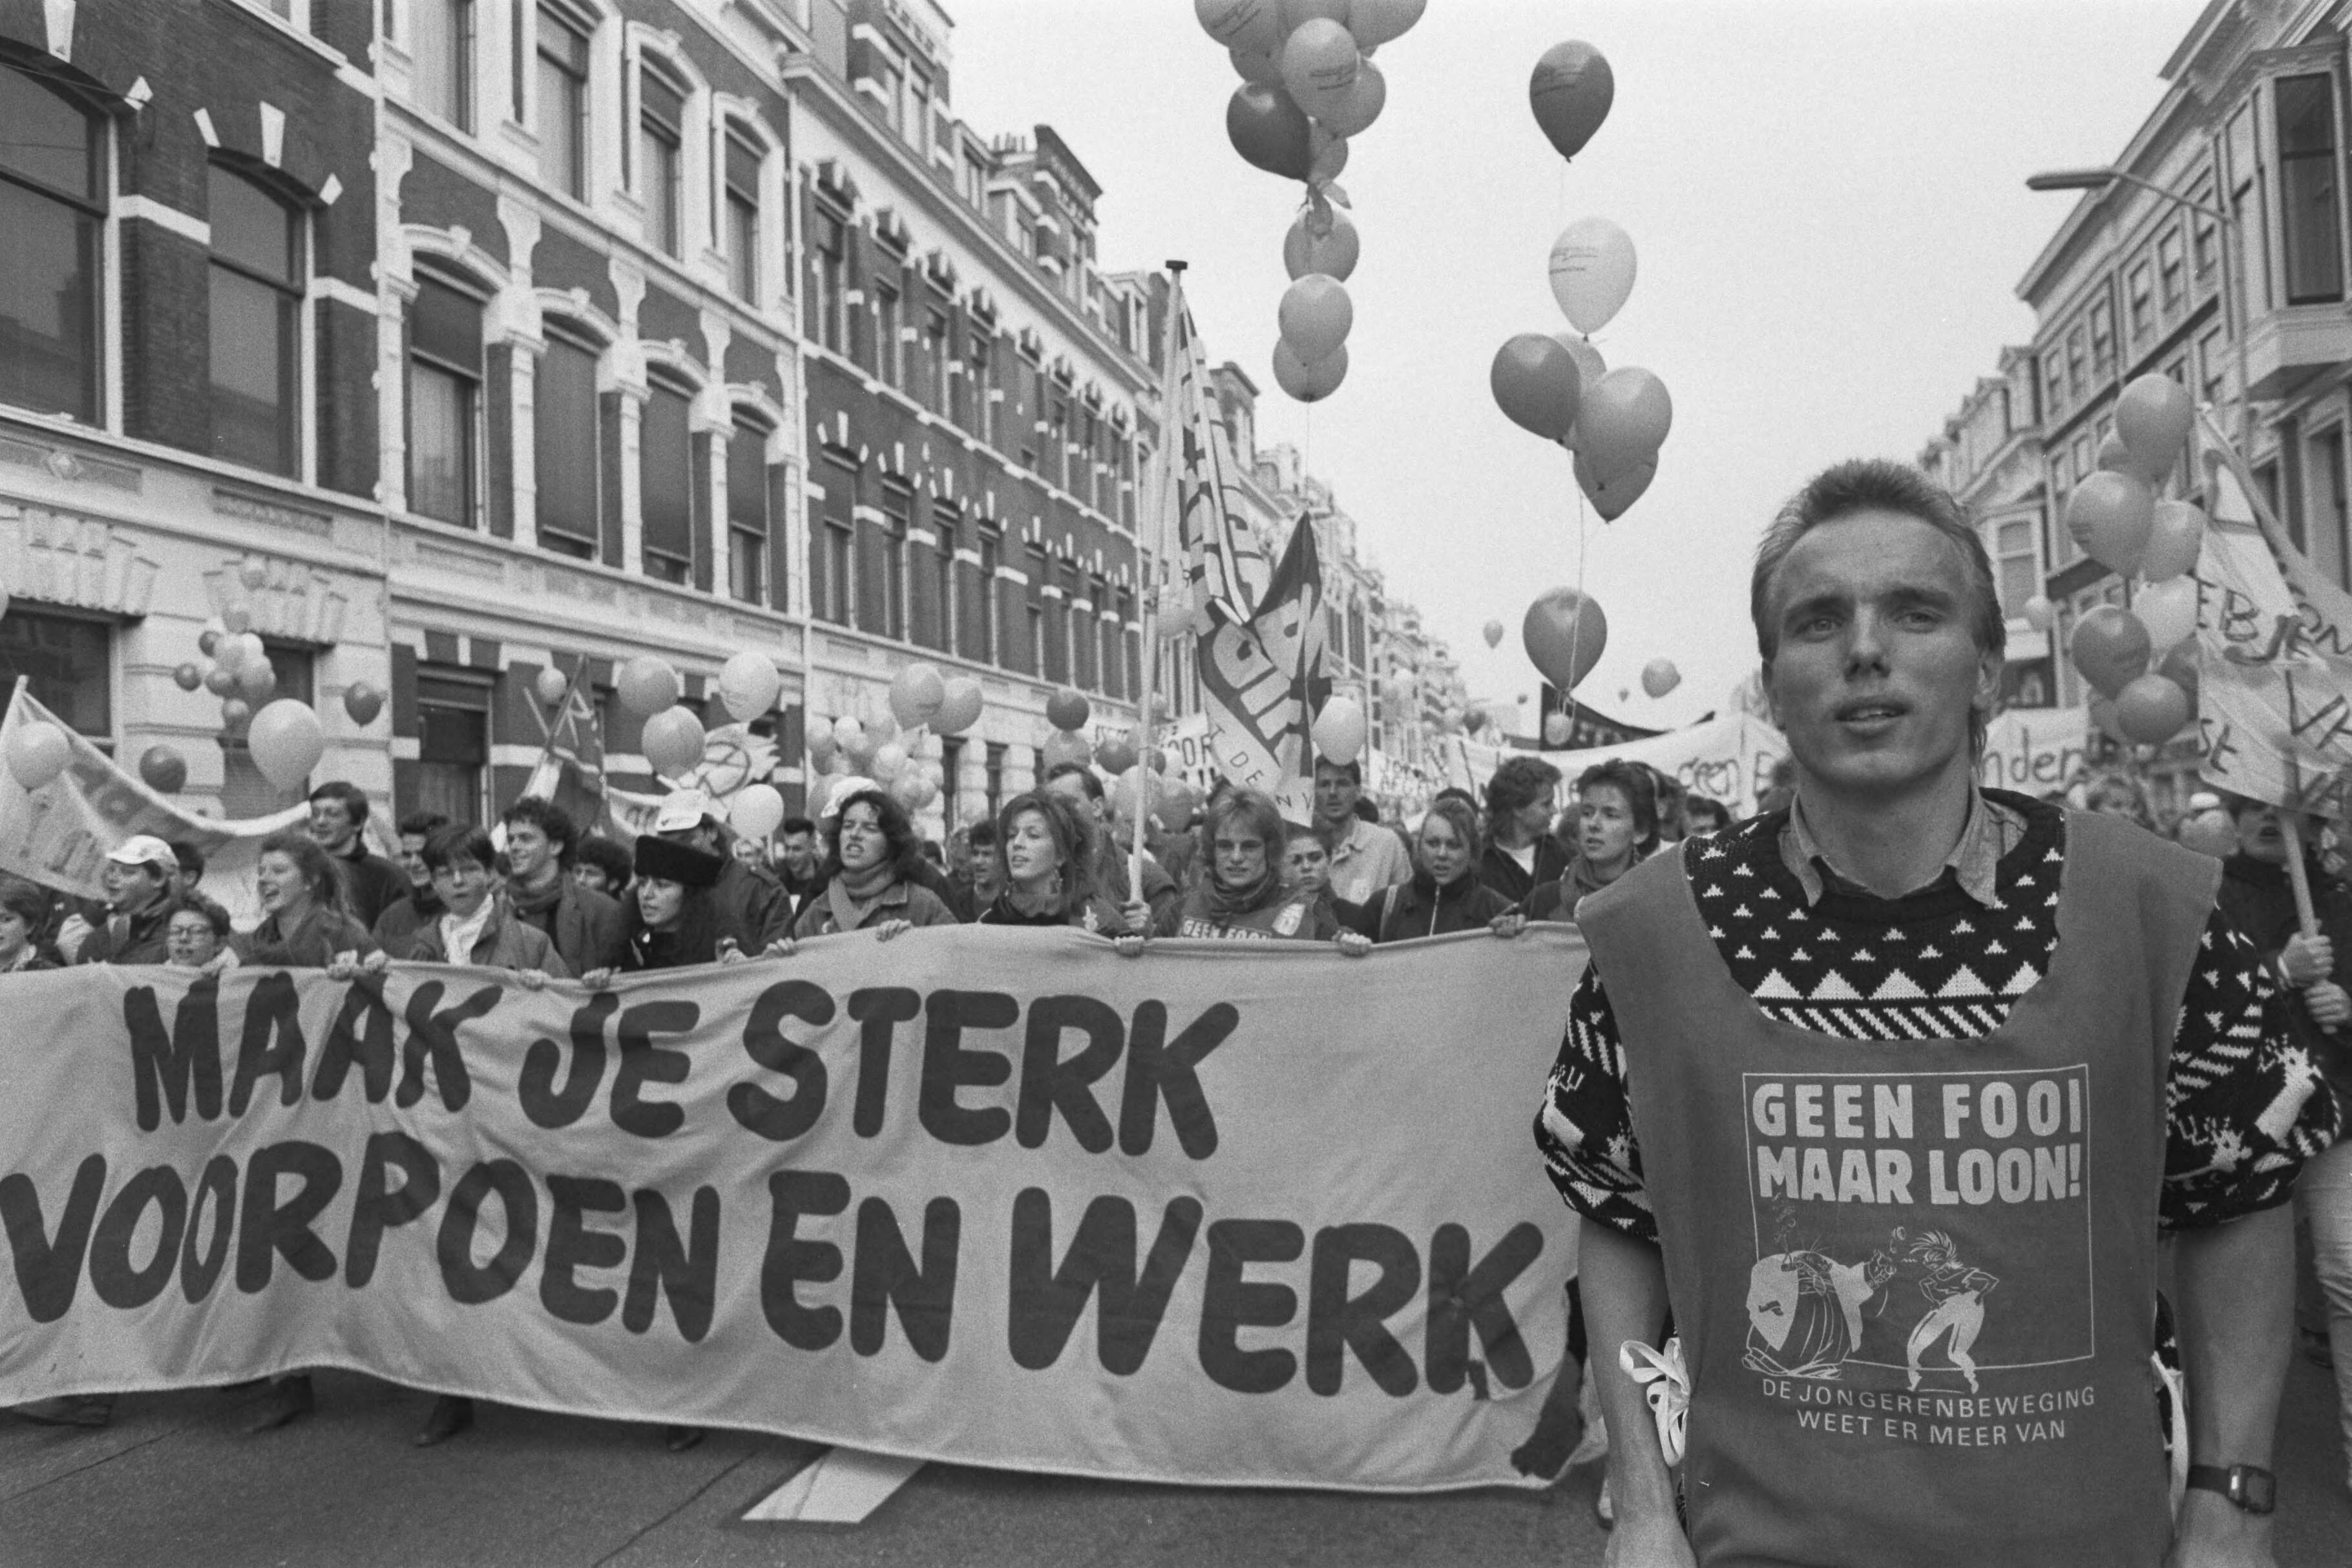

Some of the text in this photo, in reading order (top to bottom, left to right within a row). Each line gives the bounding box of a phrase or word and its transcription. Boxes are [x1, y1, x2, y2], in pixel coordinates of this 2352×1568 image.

[124, 970, 1239, 1160] MAAK JE STERK
[1752, 1078, 2081, 1140] GEEN FOOI
[1756, 1143, 2081, 1206] MAAR LOON!
[761, 1170, 961, 1363] EN
[1008, 1187, 1544, 1398] WERK
[1763, 1379, 2095, 1419] DE JONGERENBEWEGING
[1796, 1410, 2066, 1447] WEET ER MEER VAN
